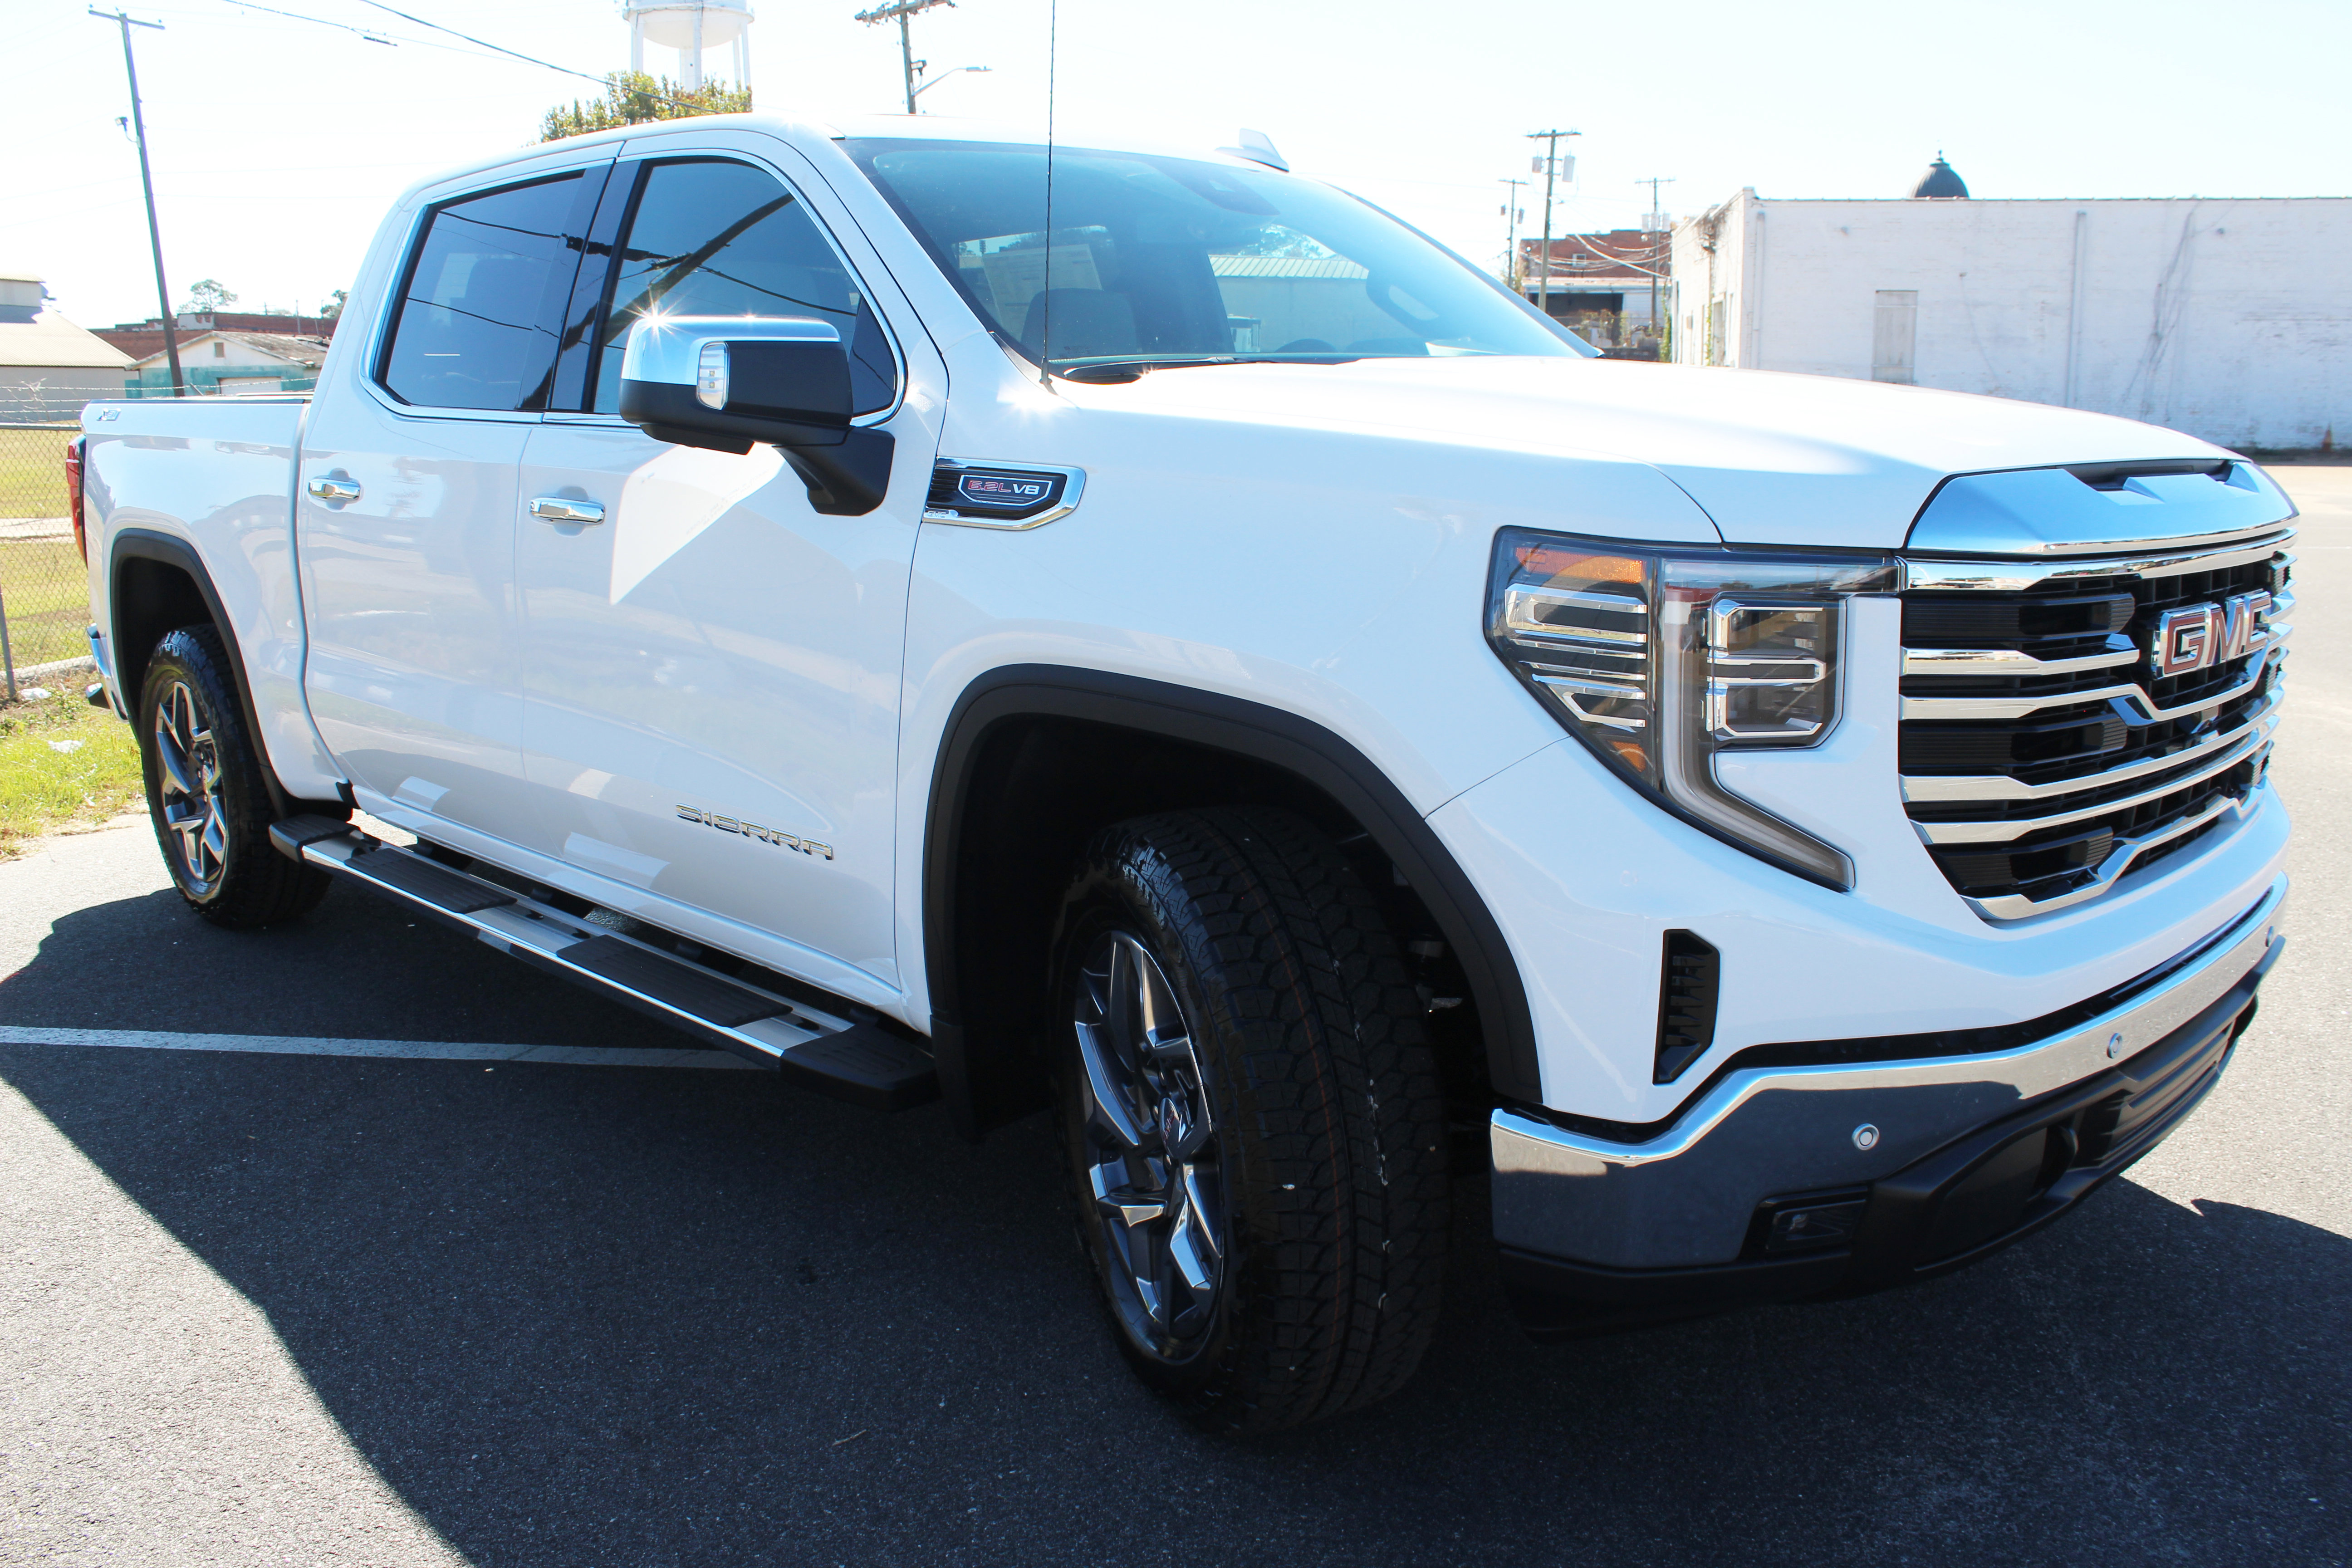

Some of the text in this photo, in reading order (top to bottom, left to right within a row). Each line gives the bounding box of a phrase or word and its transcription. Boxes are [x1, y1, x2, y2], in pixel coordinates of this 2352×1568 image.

[1012, 483, 1040, 495] V8
[2156, 591, 2271, 677] GMC
[676, 803, 834, 860] SIERRA
